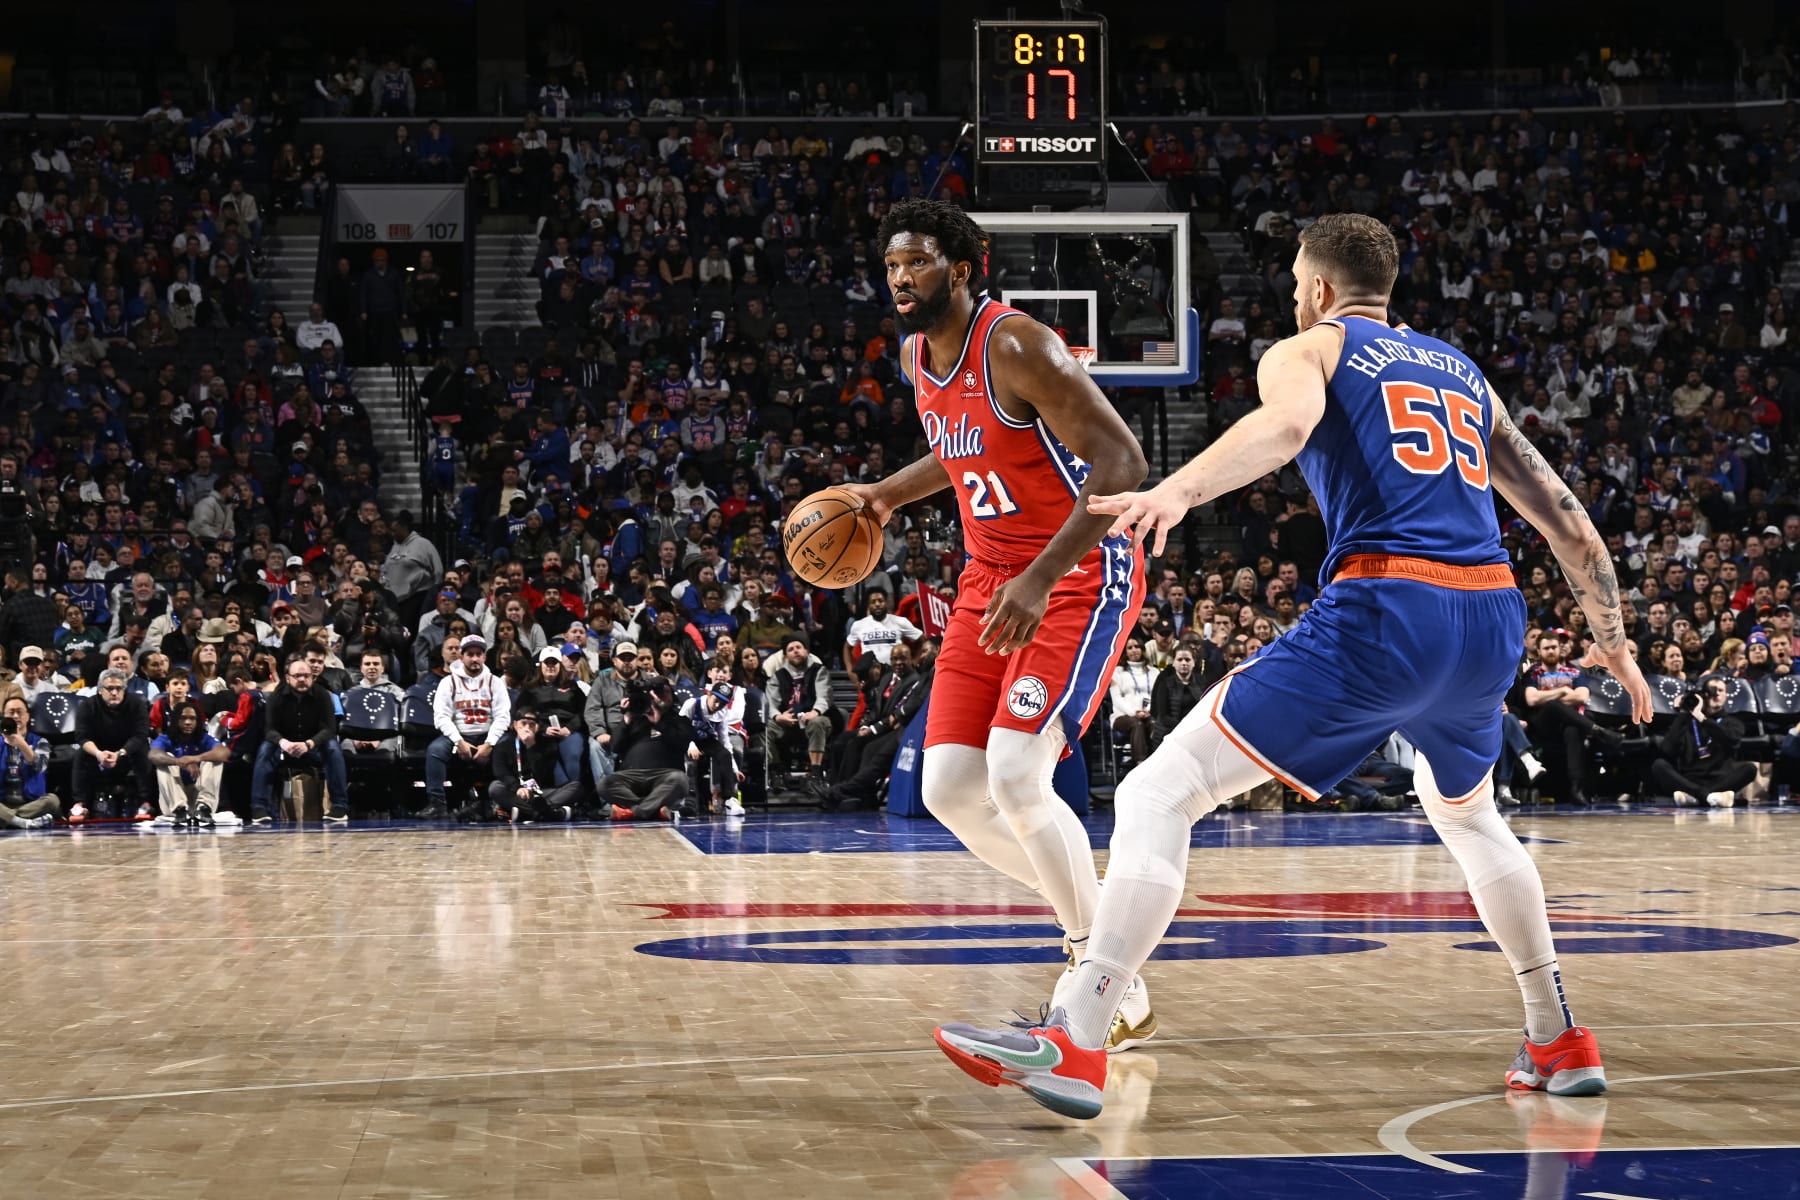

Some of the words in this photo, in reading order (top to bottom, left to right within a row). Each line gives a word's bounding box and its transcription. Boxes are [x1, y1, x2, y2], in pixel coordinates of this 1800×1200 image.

[1015, 34, 1084, 64] 8:17
[1028, 70, 1076, 119] 17
[1016, 137, 1096, 152] TISSOT
[343, 223, 376, 239] 108
[426, 223, 457, 239] 107
[923, 411, 984, 460] Phila
[1381, 381, 1489, 491] 55
[963, 471, 1021, 519] 21
[863, 631, 897, 639] 76ERS
[1011, 690, 1041, 709] 76ers
